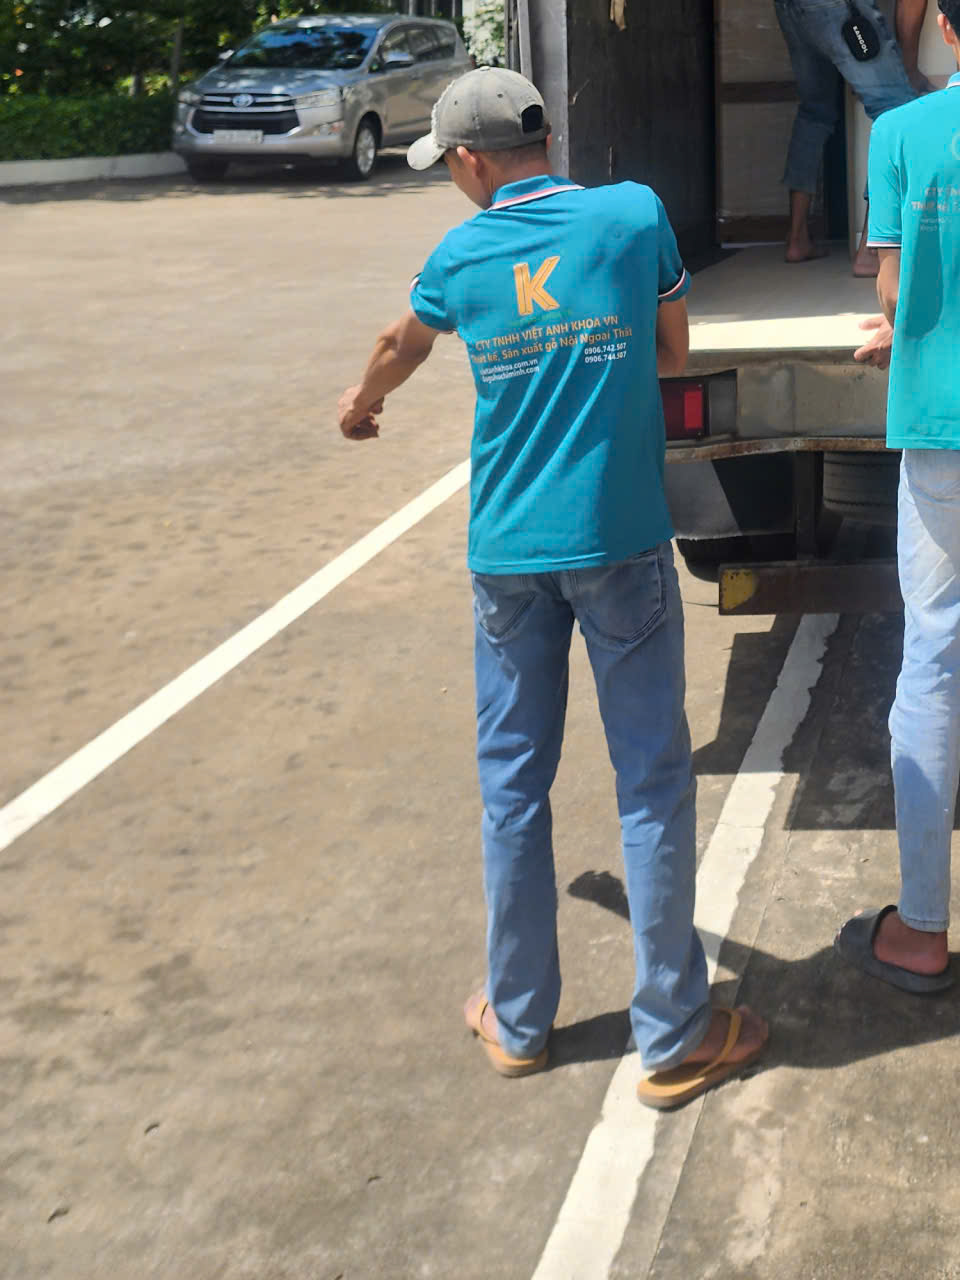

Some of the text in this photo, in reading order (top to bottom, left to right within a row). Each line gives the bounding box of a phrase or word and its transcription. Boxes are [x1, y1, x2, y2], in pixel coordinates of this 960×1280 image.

[852, 25, 869, 54] KANGOL
[513, 255, 561, 316] K
[475, 339, 490, 352] CTY
[492, 332, 521, 347] TNHH
[545, 322, 569, 337] ANH
[571, 317, 601, 331] KHOA
[603, 315, 619, 326] VN
[584, 342, 628, 355] 0906.742.507
